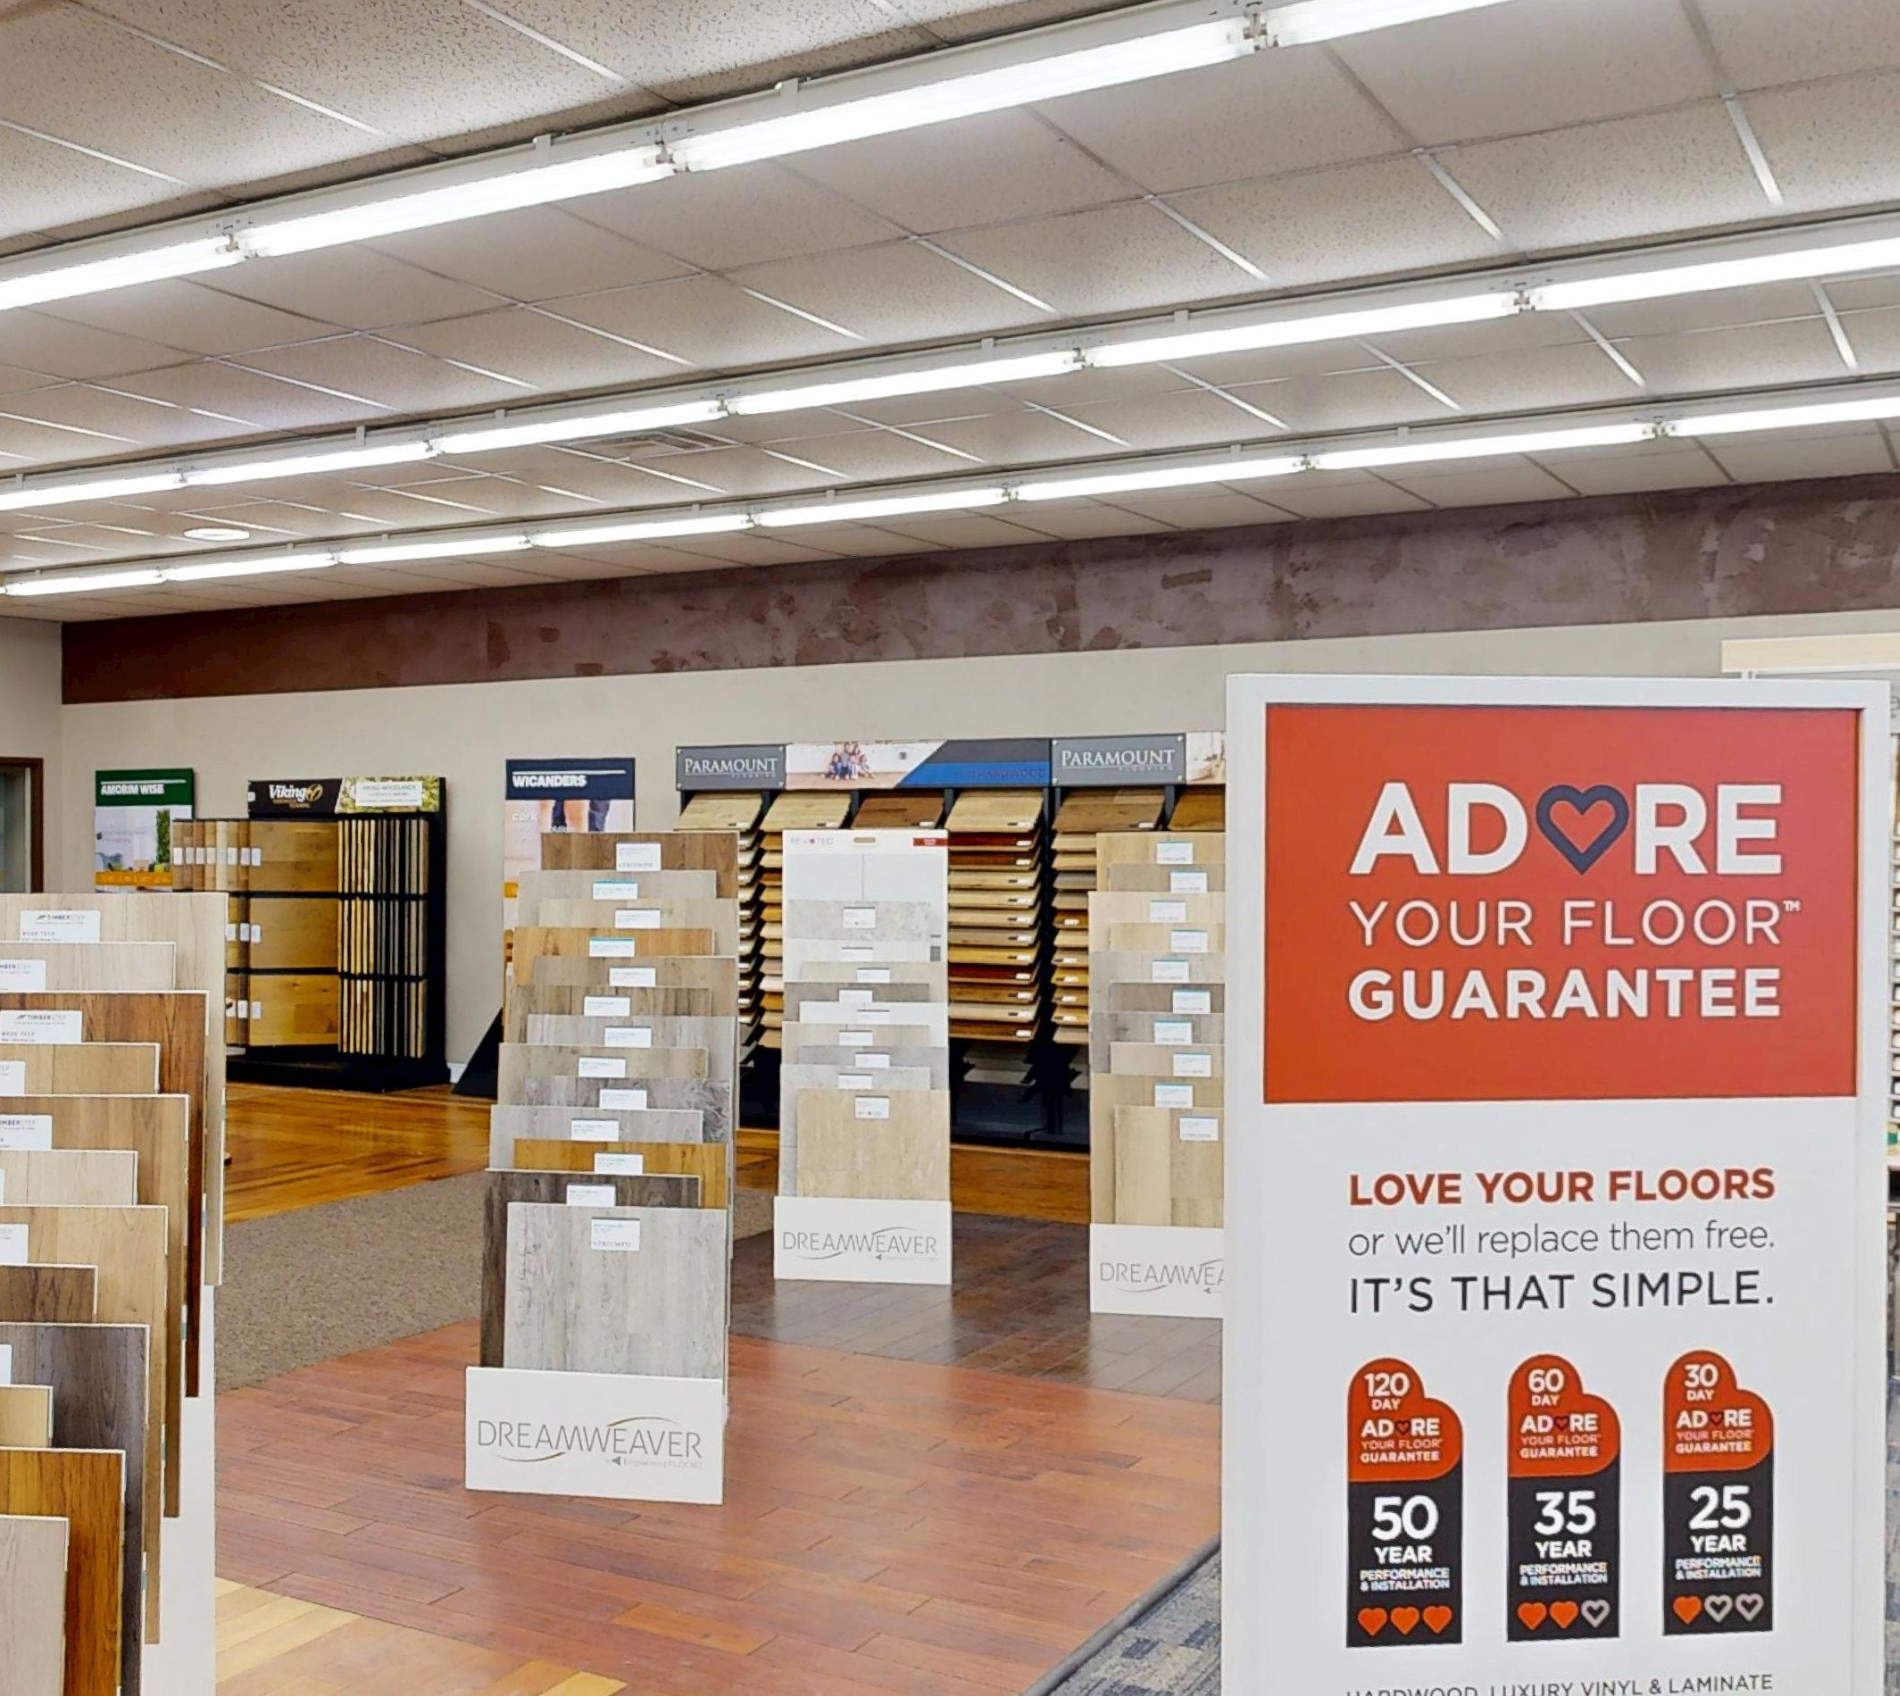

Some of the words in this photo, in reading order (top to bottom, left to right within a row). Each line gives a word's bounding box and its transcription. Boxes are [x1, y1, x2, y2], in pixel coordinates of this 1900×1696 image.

[684, 758, 778, 773] PARAMOUNT
[1061, 749, 1176, 767] PARAMOUNT
[100, 784, 139, 796] AMORIM
[140, 783, 165, 795] WISE
[512, 775, 588, 788] WICANDERS
[268, 784, 307, 803] Viking
[1349, 899, 1534, 946] YOUR
[1348, 968, 1782, 1021] GUARANTEE
[1350, 1173, 1462, 1206] LOVE
[1476, 1170, 1594, 1204] YOUR
[1609, 1168, 1776, 1202] FLOORS
[783, 1231, 939, 1254] DREAMWEAVER
[1348, 1232, 1384, 1256] or
[1395, 1224, 1466, 1255] we'll
[1477, 1223, 1599, 1258] replace
[1609, 1222, 1694, 1251] them
[1705, 1219, 1775, 1249] free.
[1350, 1276, 1433, 1313] IT'S
[1451, 1274, 1575, 1311] THAT
[1591, 1270, 1774, 1308] SIMPLE.
[1364, 1372, 1410, 1397] 120
[1528, 1368, 1565, 1393] 60
[1684, 1363, 1719, 1388] 30
[1531, 1395, 1560, 1406] DAY
[1686, 1389, 1715, 1401] DAY
[1371, 1399, 1401, 1411] DAY
[478, 1420, 703, 1458] DREAMWEAVER
[1361, 1440, 1395, 1450] YOUR
[1521, 1435, 1554, 1446] YOUR
[1676, 1431, 1709, 1441] YOUR
[1360, 1450, 1440, 1463] GUARANTEE
[1519, 1446, 1598, 1459] GUARANTEE
[1675, 1441, 1753, 1454] GUARANTEE
[1534, 1490, 1597, 1535] 35
[1689, 1485, 1752, 1530] 25
[1371, 1494, 1439, 1541] 50
[1535, 1540, 1592, 1559] YEAR
[1690, 1534, 1747, 1553] YEAR
[1374, 1545, 1433, 1564] YEAR
[1675, 1555, 1762, 1569] PERFORMANCE
[1360, 1567, 1450, 1581] PERFORMANCE
[1519, 1562, 1608, 1576] PERFORMANCE
[1686, 1567, 1762, 1580] INSTALLATION
[1370, 1579, 1450, 1591] INSTALLATION
[1529, 1573, 1608, 1586] INSTALLATION
[1580, 1680, 1643, 1696] VINYL
[1648, 1678, 1662, 1694] &
[1669, 1674, 1773, 1693] LAMINATE
